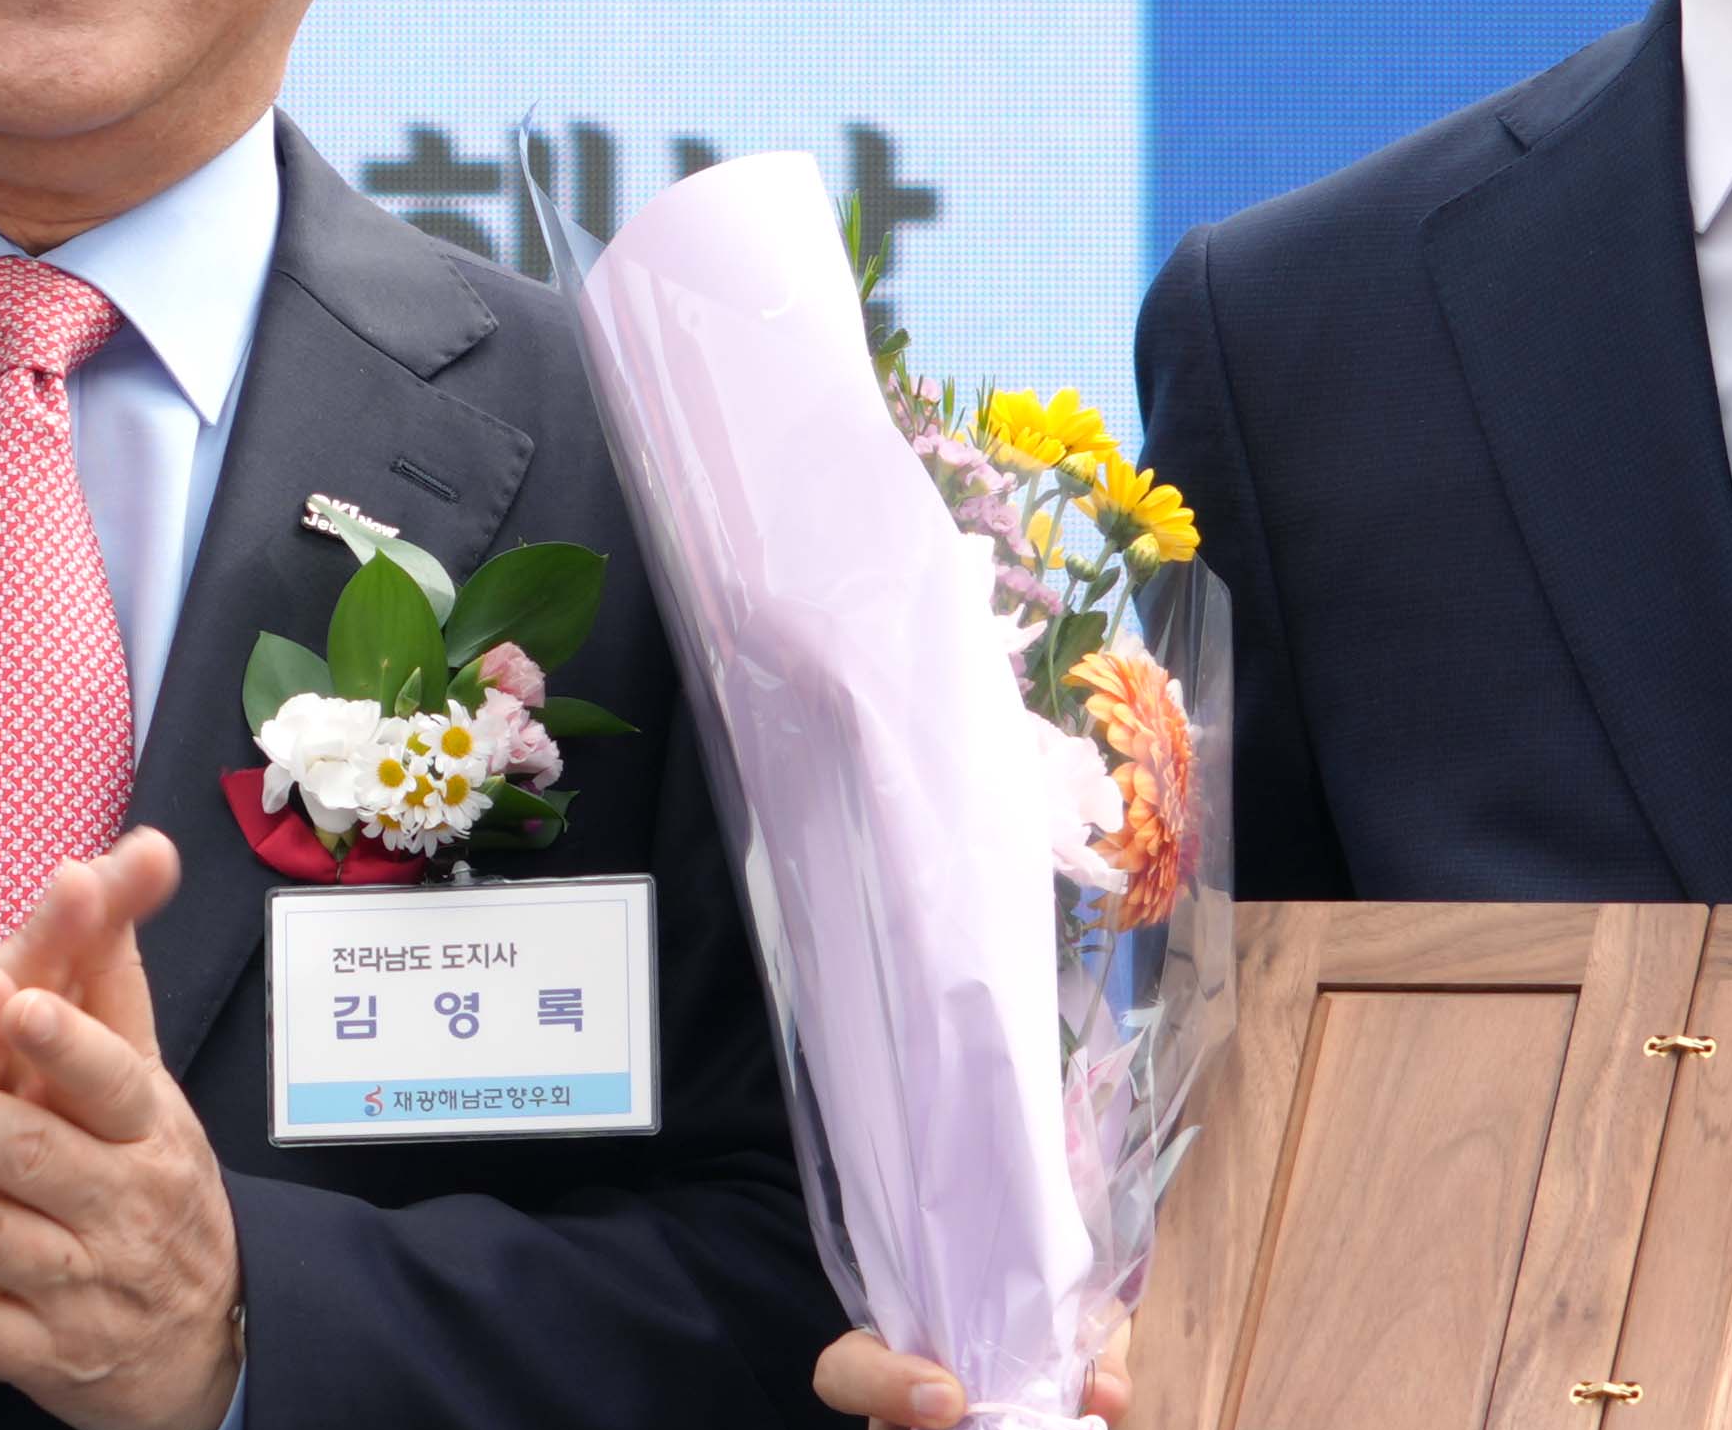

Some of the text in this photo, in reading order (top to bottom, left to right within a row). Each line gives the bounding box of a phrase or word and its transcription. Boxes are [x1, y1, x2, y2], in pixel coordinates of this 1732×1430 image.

[332, 942, 518, 974] 전라남도 도지사
[333, 988, 584, 1040] 김 영 록
[393, 1085, 571, 1112] 재광해남군향우회
